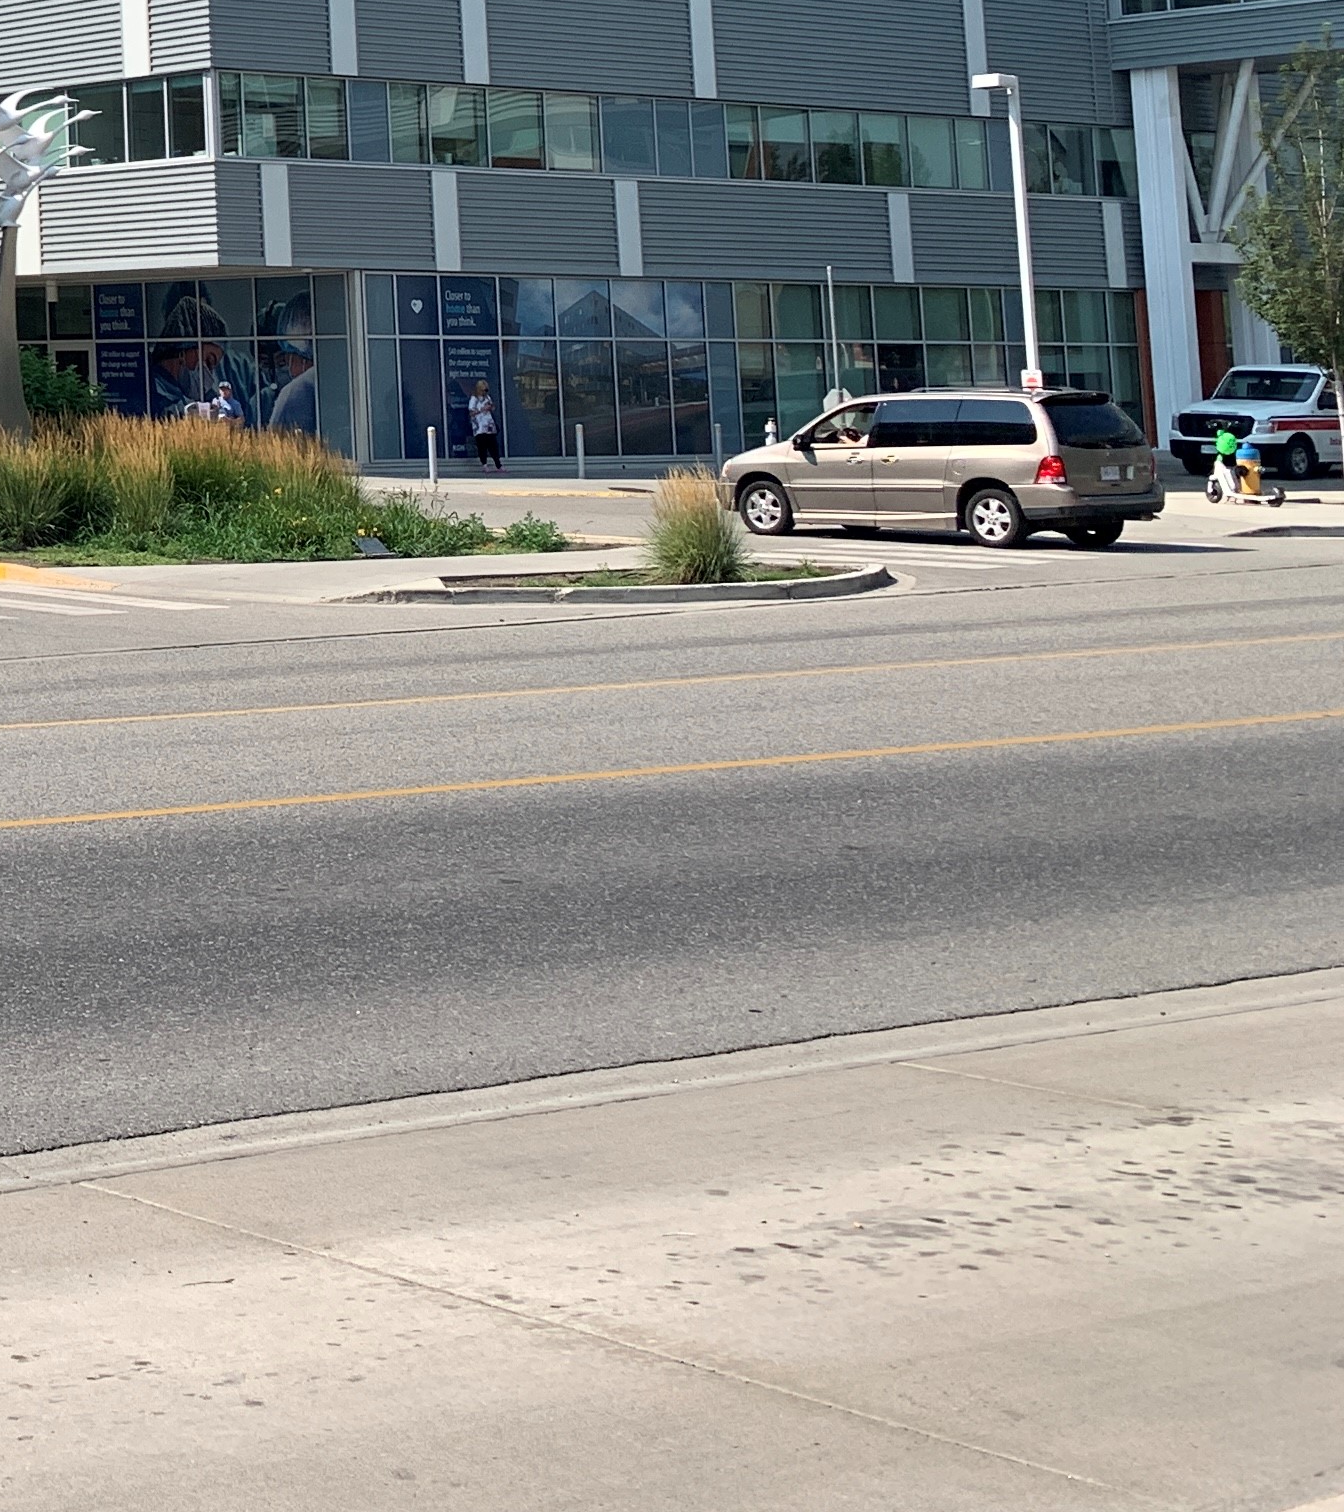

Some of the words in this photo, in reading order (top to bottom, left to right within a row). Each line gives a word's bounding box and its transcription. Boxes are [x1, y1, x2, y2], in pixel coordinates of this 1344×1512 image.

[98, 294, 117, 305] Closer
[118, 295, 126, 304] to
[445, 290, 464, 301] Closer
[464, 292, 472, 301] to
[120, 306, 135, 317] than
[446, 303, 465, 314] home
[466, 303, 481, 314] than
[100, 322, 112, 333] you
[446, 318, 458, 329] you
